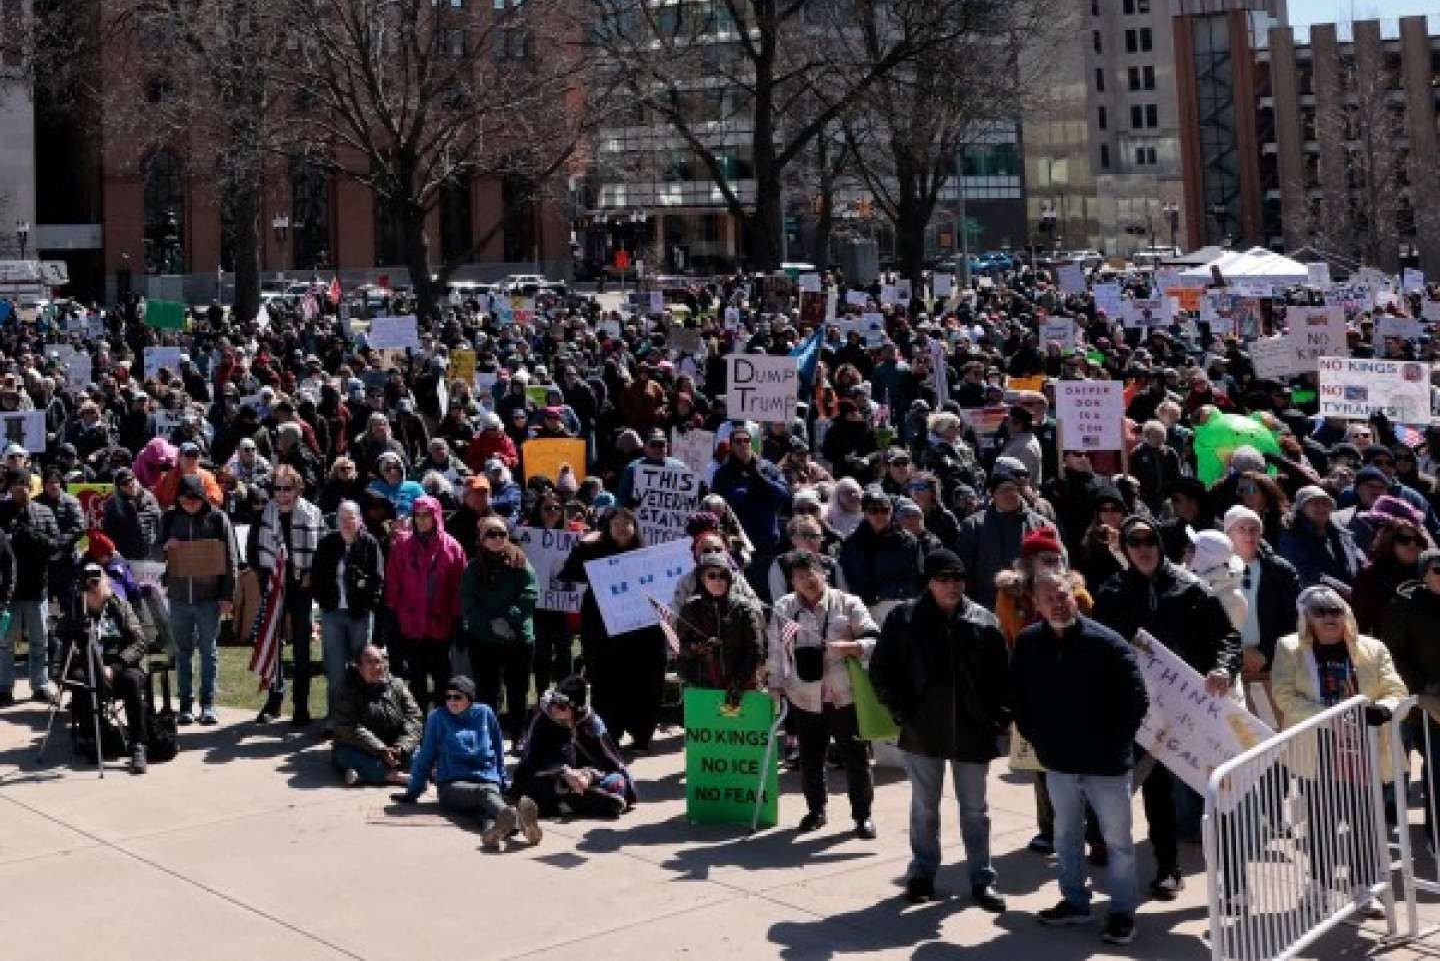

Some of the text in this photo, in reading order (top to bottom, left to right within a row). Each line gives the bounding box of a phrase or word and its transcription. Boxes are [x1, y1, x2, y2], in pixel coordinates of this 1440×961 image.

[1320, 360, 1398, 374] NO KINGS
[1321, 385, 1343, 396] NO
[643, 468, 694, 491] THIS
[1145, 651, 1222, 720] THINK
[686, 728, 768, 745] NO KINGS
[701, 757, 761, 775] NO ICE
[695, 786, 719, 801] NO
